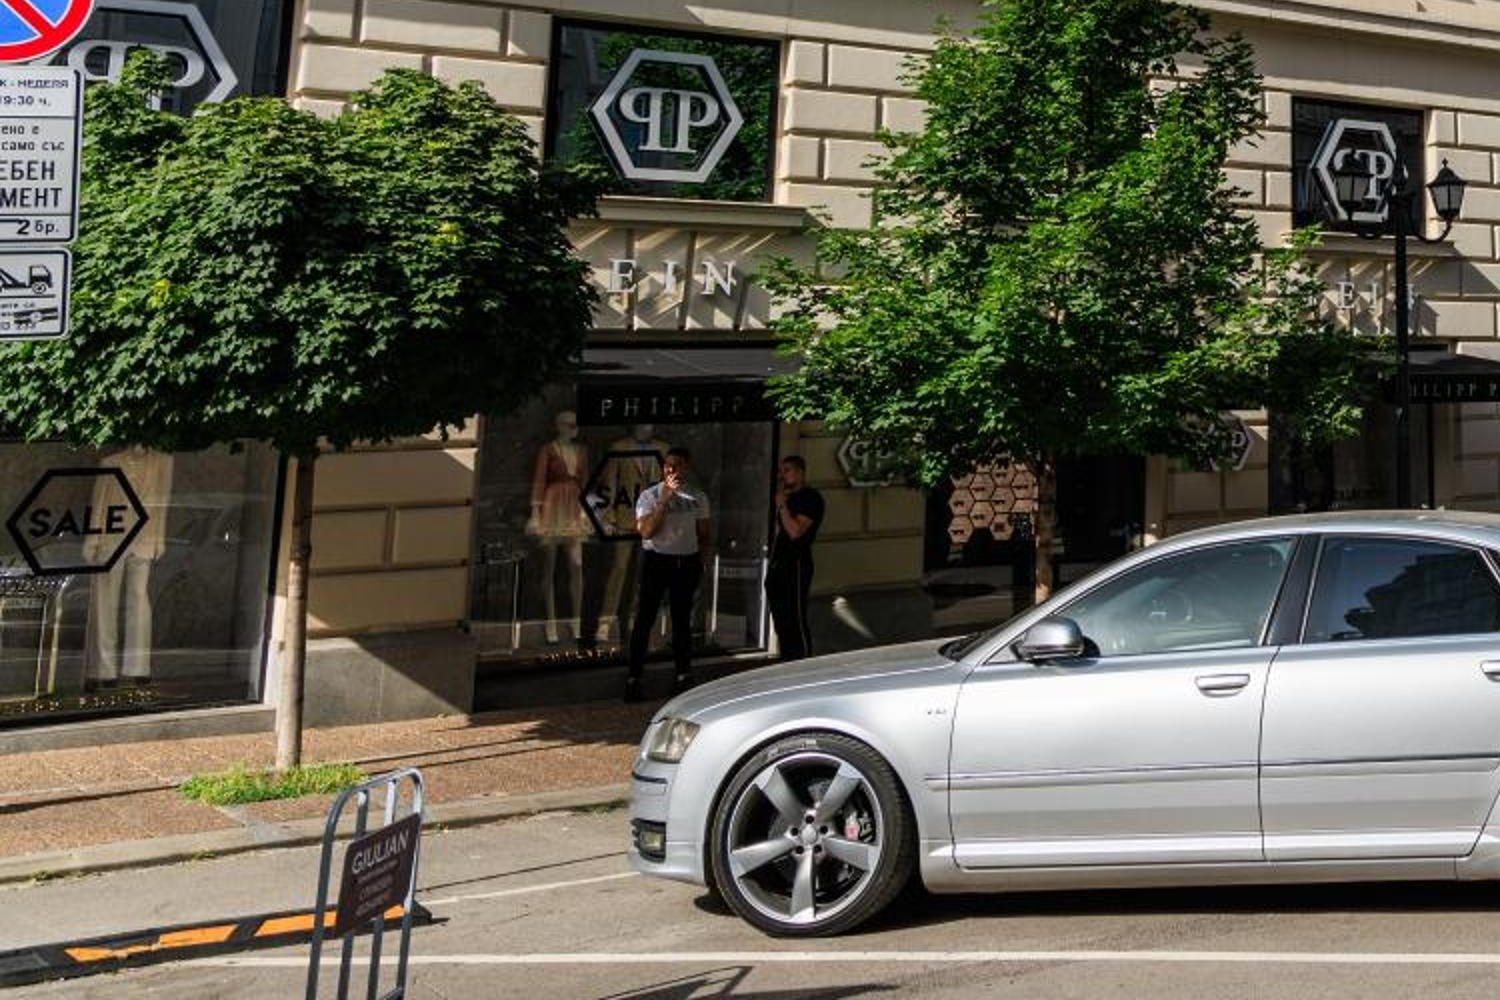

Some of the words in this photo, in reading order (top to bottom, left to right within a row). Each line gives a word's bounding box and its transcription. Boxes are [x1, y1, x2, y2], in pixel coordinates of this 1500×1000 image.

[17, 79, 69, 89] НЕДЕЛЯ
[1, 125, 26, 135] ено
[0, 160, 55, 181] ЕБЕН
[0, 187, 63, 208] МЕНТ
[607, 257, 738, 297] EIN
[28, 504, 128, 537] SALE
